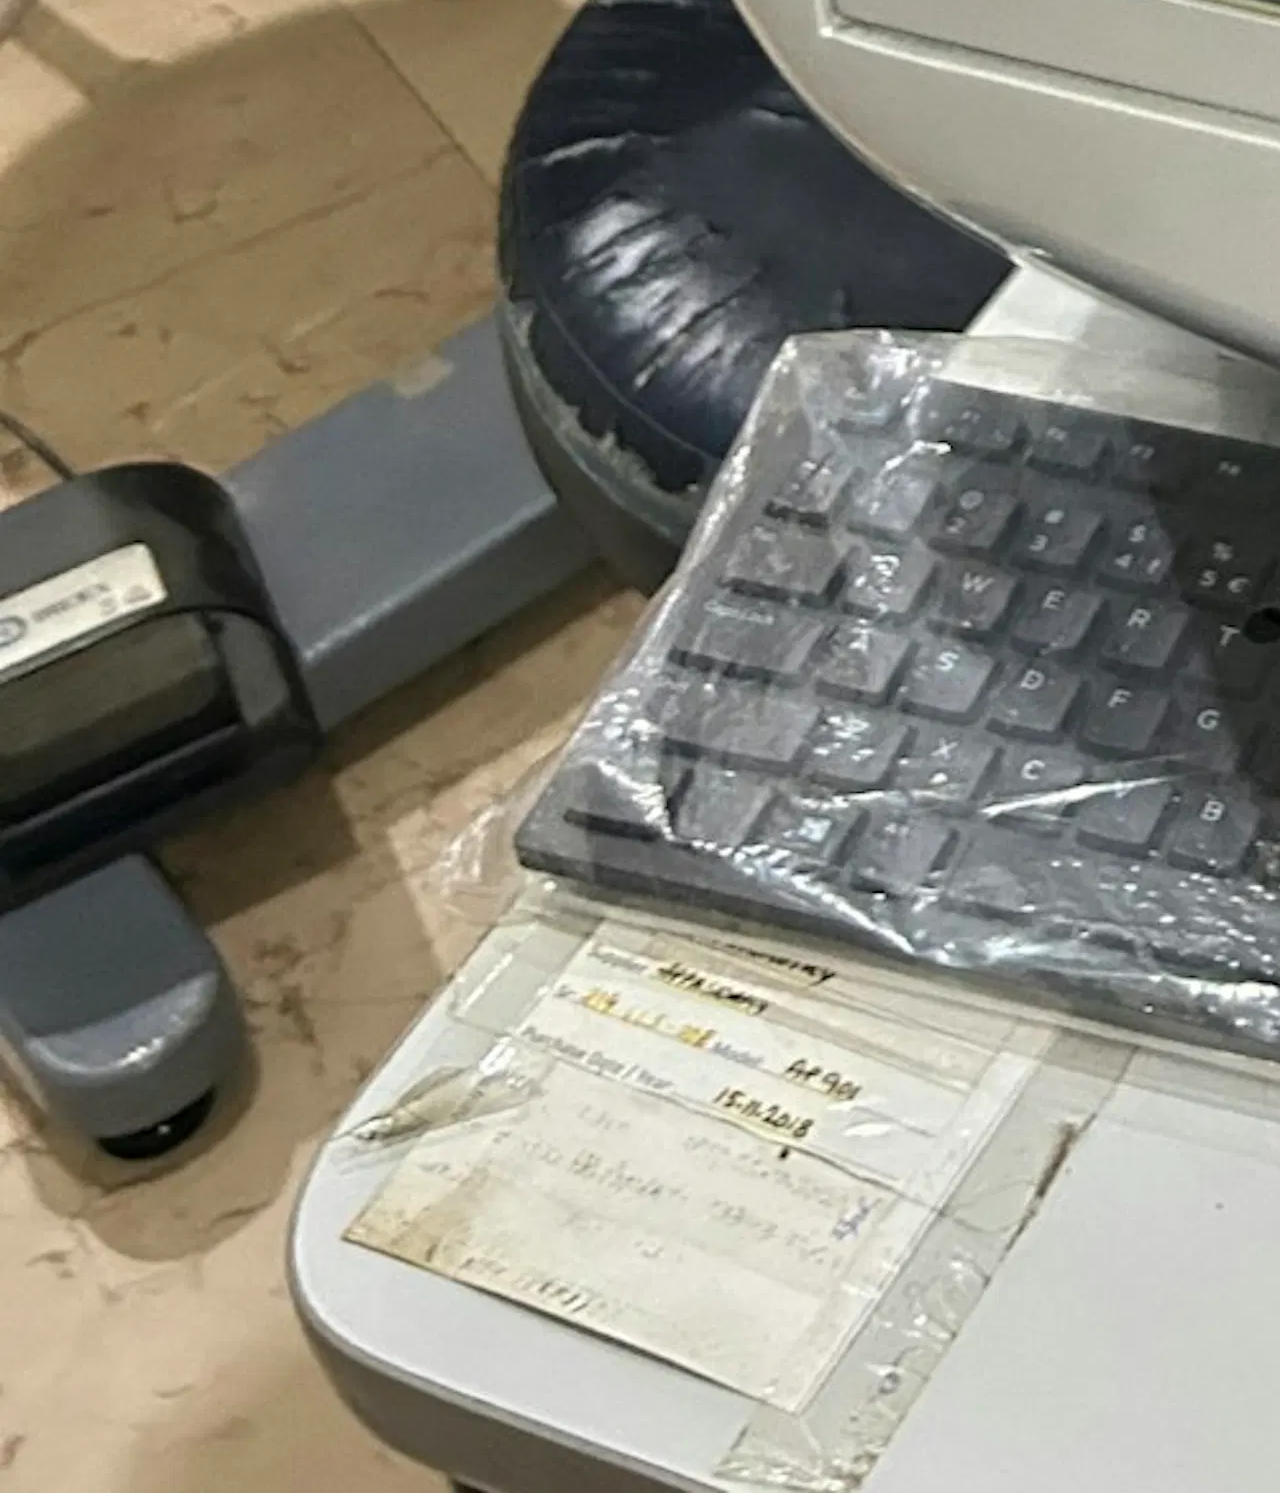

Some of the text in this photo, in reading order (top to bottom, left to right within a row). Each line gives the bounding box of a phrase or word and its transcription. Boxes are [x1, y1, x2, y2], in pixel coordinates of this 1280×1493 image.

[962, 572, 995, 594] W
[1042, 590, 1065, 611] E
[1126, 608, 1151, 629] R
[1219, 624, 1241, 647] T
[935, 651, 959, 673] S
[1016, 669, 1045, 691] D
[1106, 689, 1131, 708] F
[1196, 709, 1220, 731] G
[931, 740, 958, 760] X
[1021, 759, 1046, 781] C
[1199, 800, 1224, 822] B
